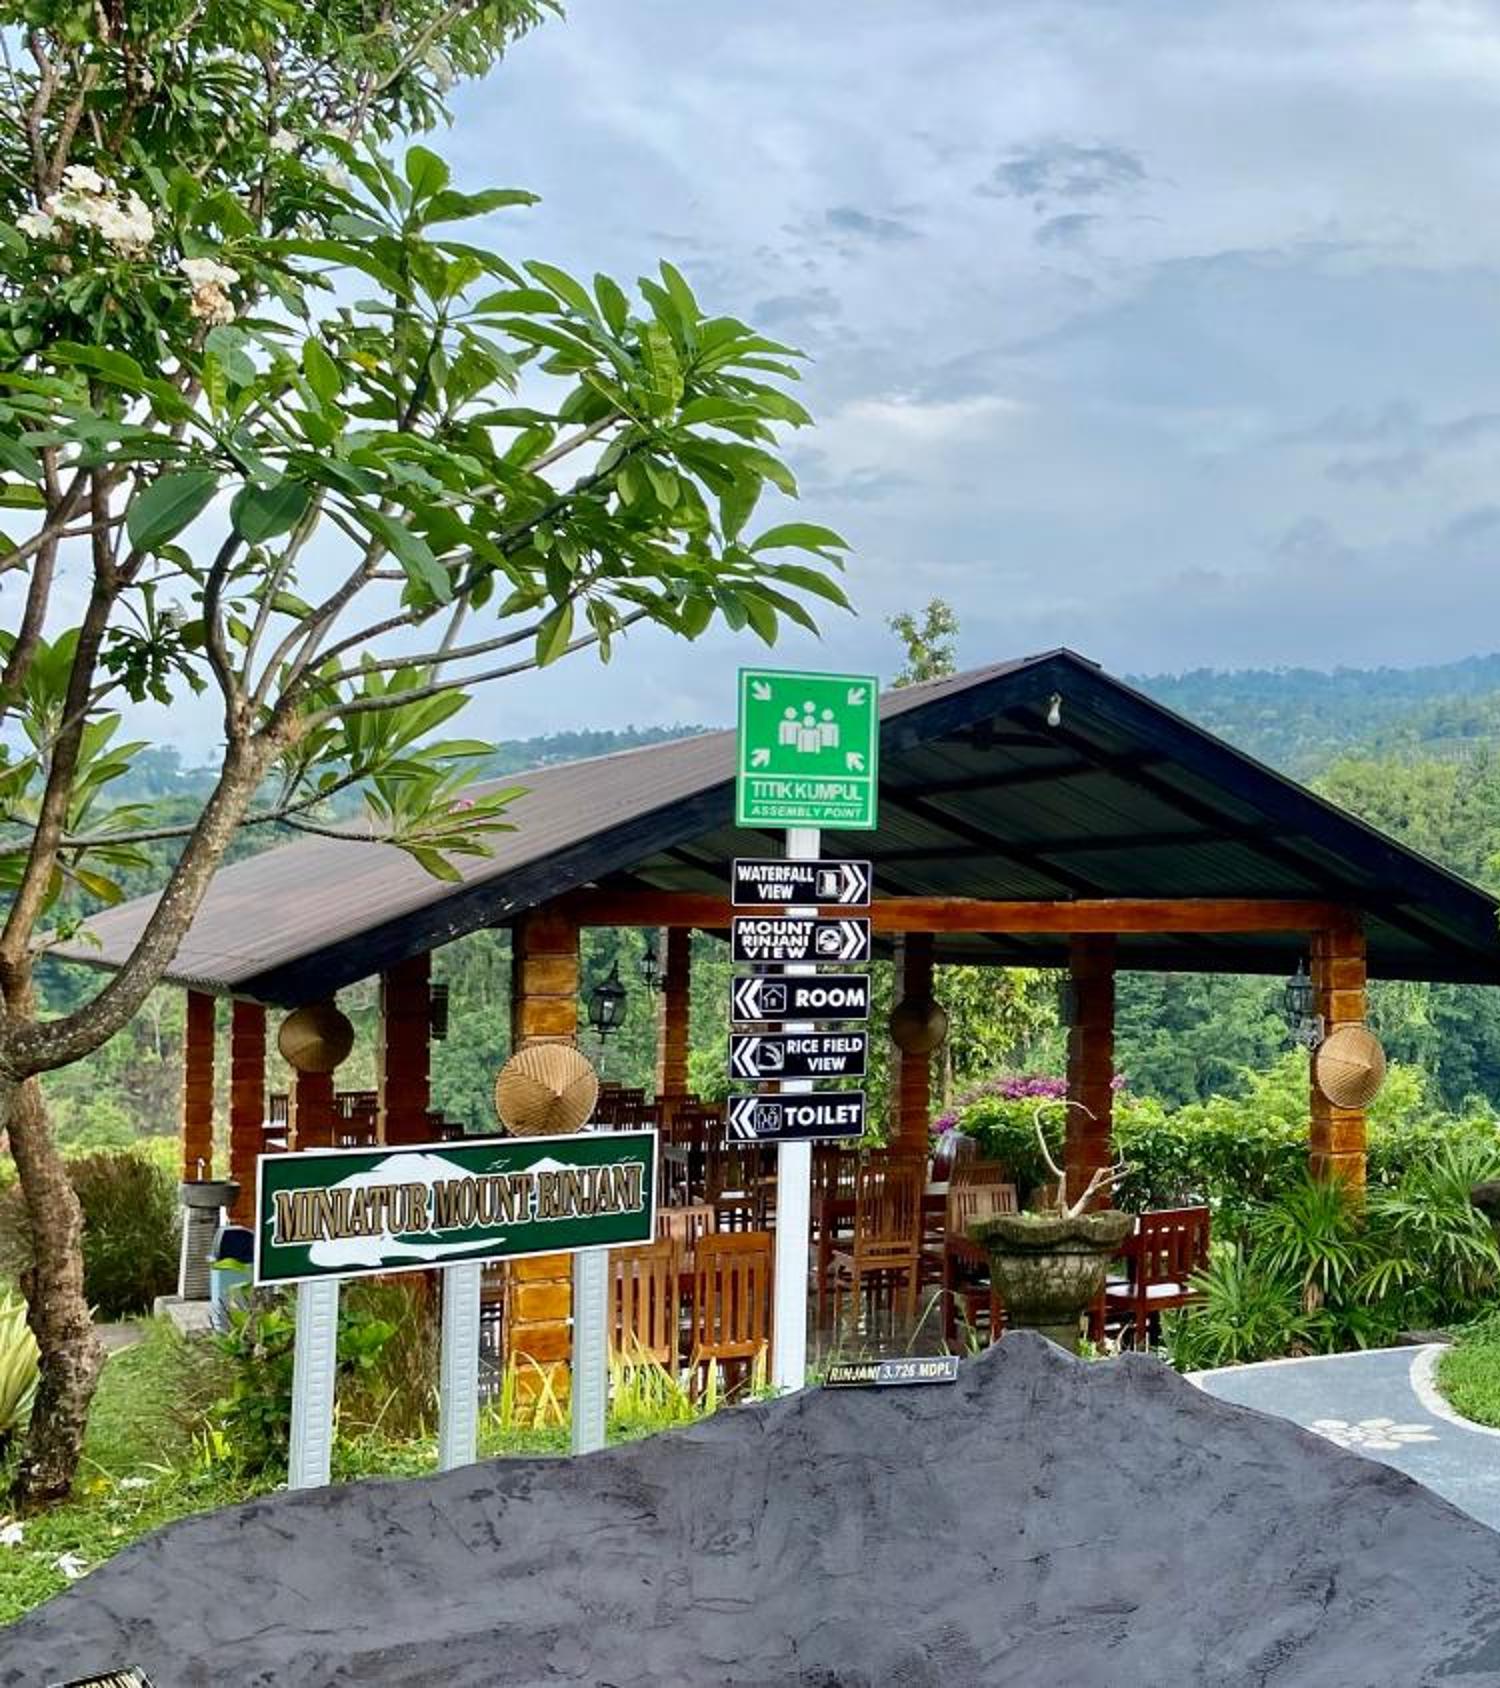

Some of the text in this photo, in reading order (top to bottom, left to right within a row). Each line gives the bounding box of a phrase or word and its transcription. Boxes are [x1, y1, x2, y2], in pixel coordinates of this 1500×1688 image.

[751, 780, 864, 801] TITIK KUMPUL
[751, 805, 863, 818] ASSEMBLY POINT
[737, 865, 815, 882] WATERFALL
[757, 884, 794, 899] VIEW
[737, 920, 815, 936] MOUNT
[741, 936, 809, 947] RINJANI
[743, 947, 807, 959] VIEW
[795, 989, 864, 1007] ROOM
[787, 1037, 863, 1053] RICE FIELD
[807, 1056, 847, 1071] VIEW
[784, 1104, 860, 1126] TOILET
[274, 1163, 645, 1244] MINIATUR MOUNT RINJANI
